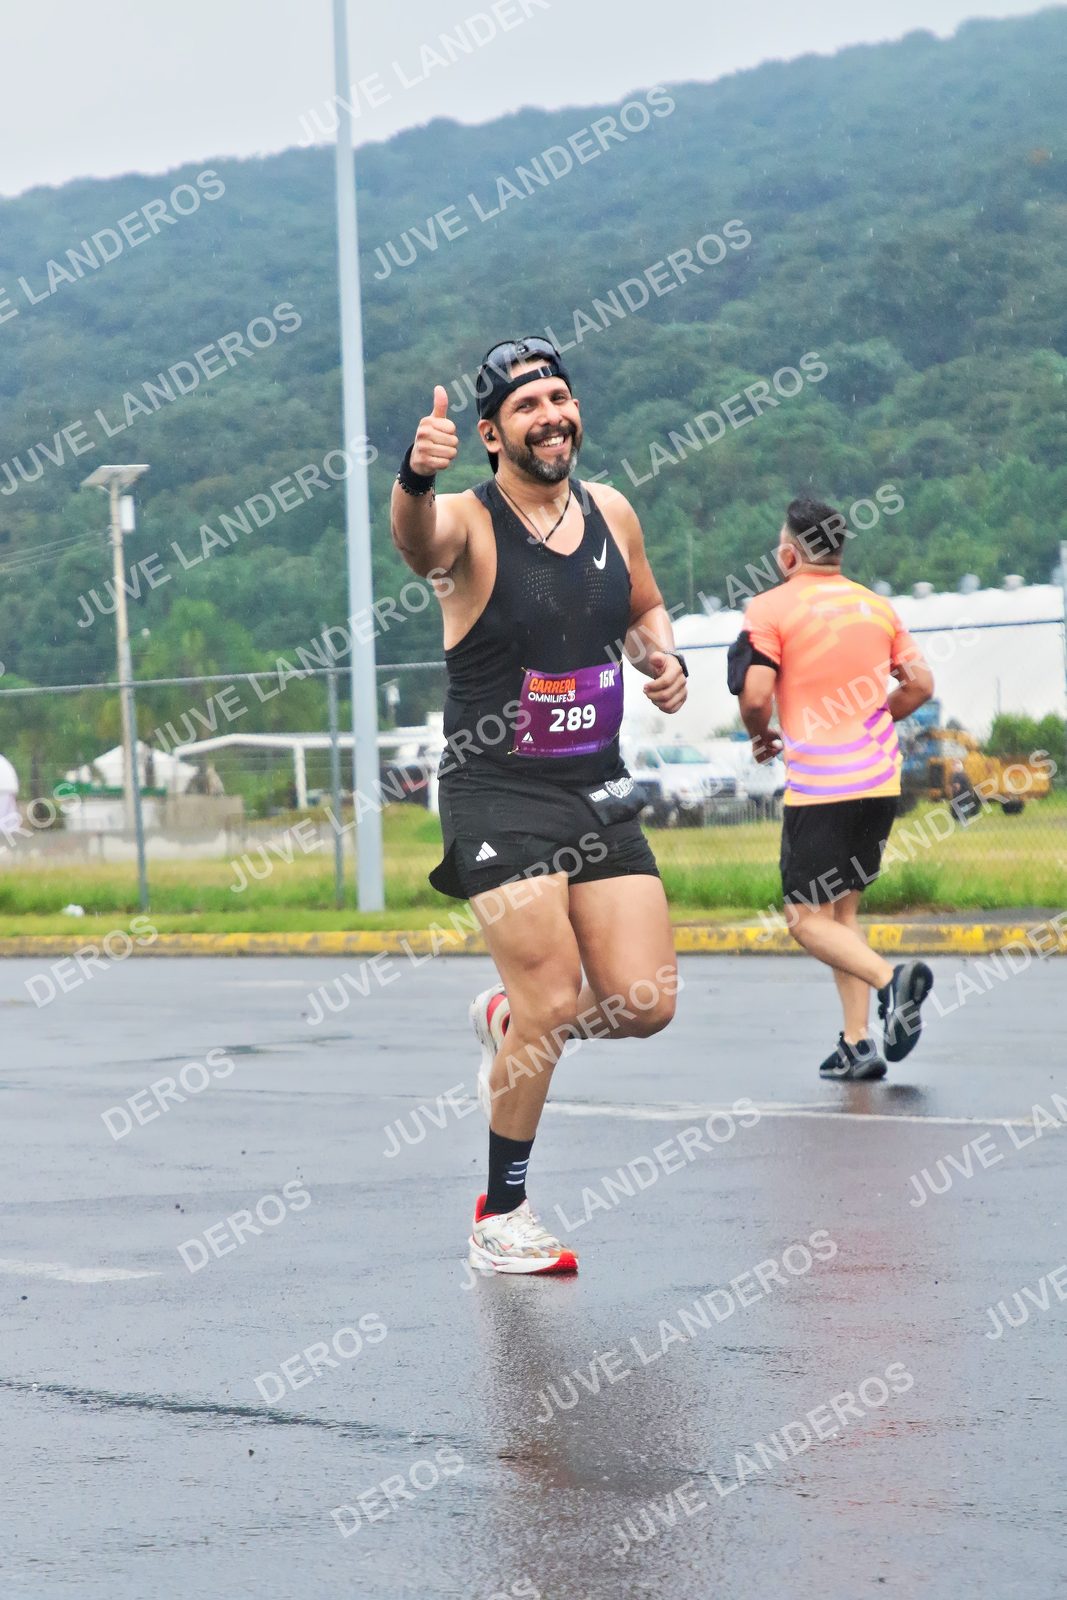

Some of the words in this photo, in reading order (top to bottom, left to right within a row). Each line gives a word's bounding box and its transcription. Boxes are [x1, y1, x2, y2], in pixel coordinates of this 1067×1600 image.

[529, 677, 576, 694] CARRERA
[528, 691, 567, 703] OMNILIFE
[549, 704, 596, 732] 289
